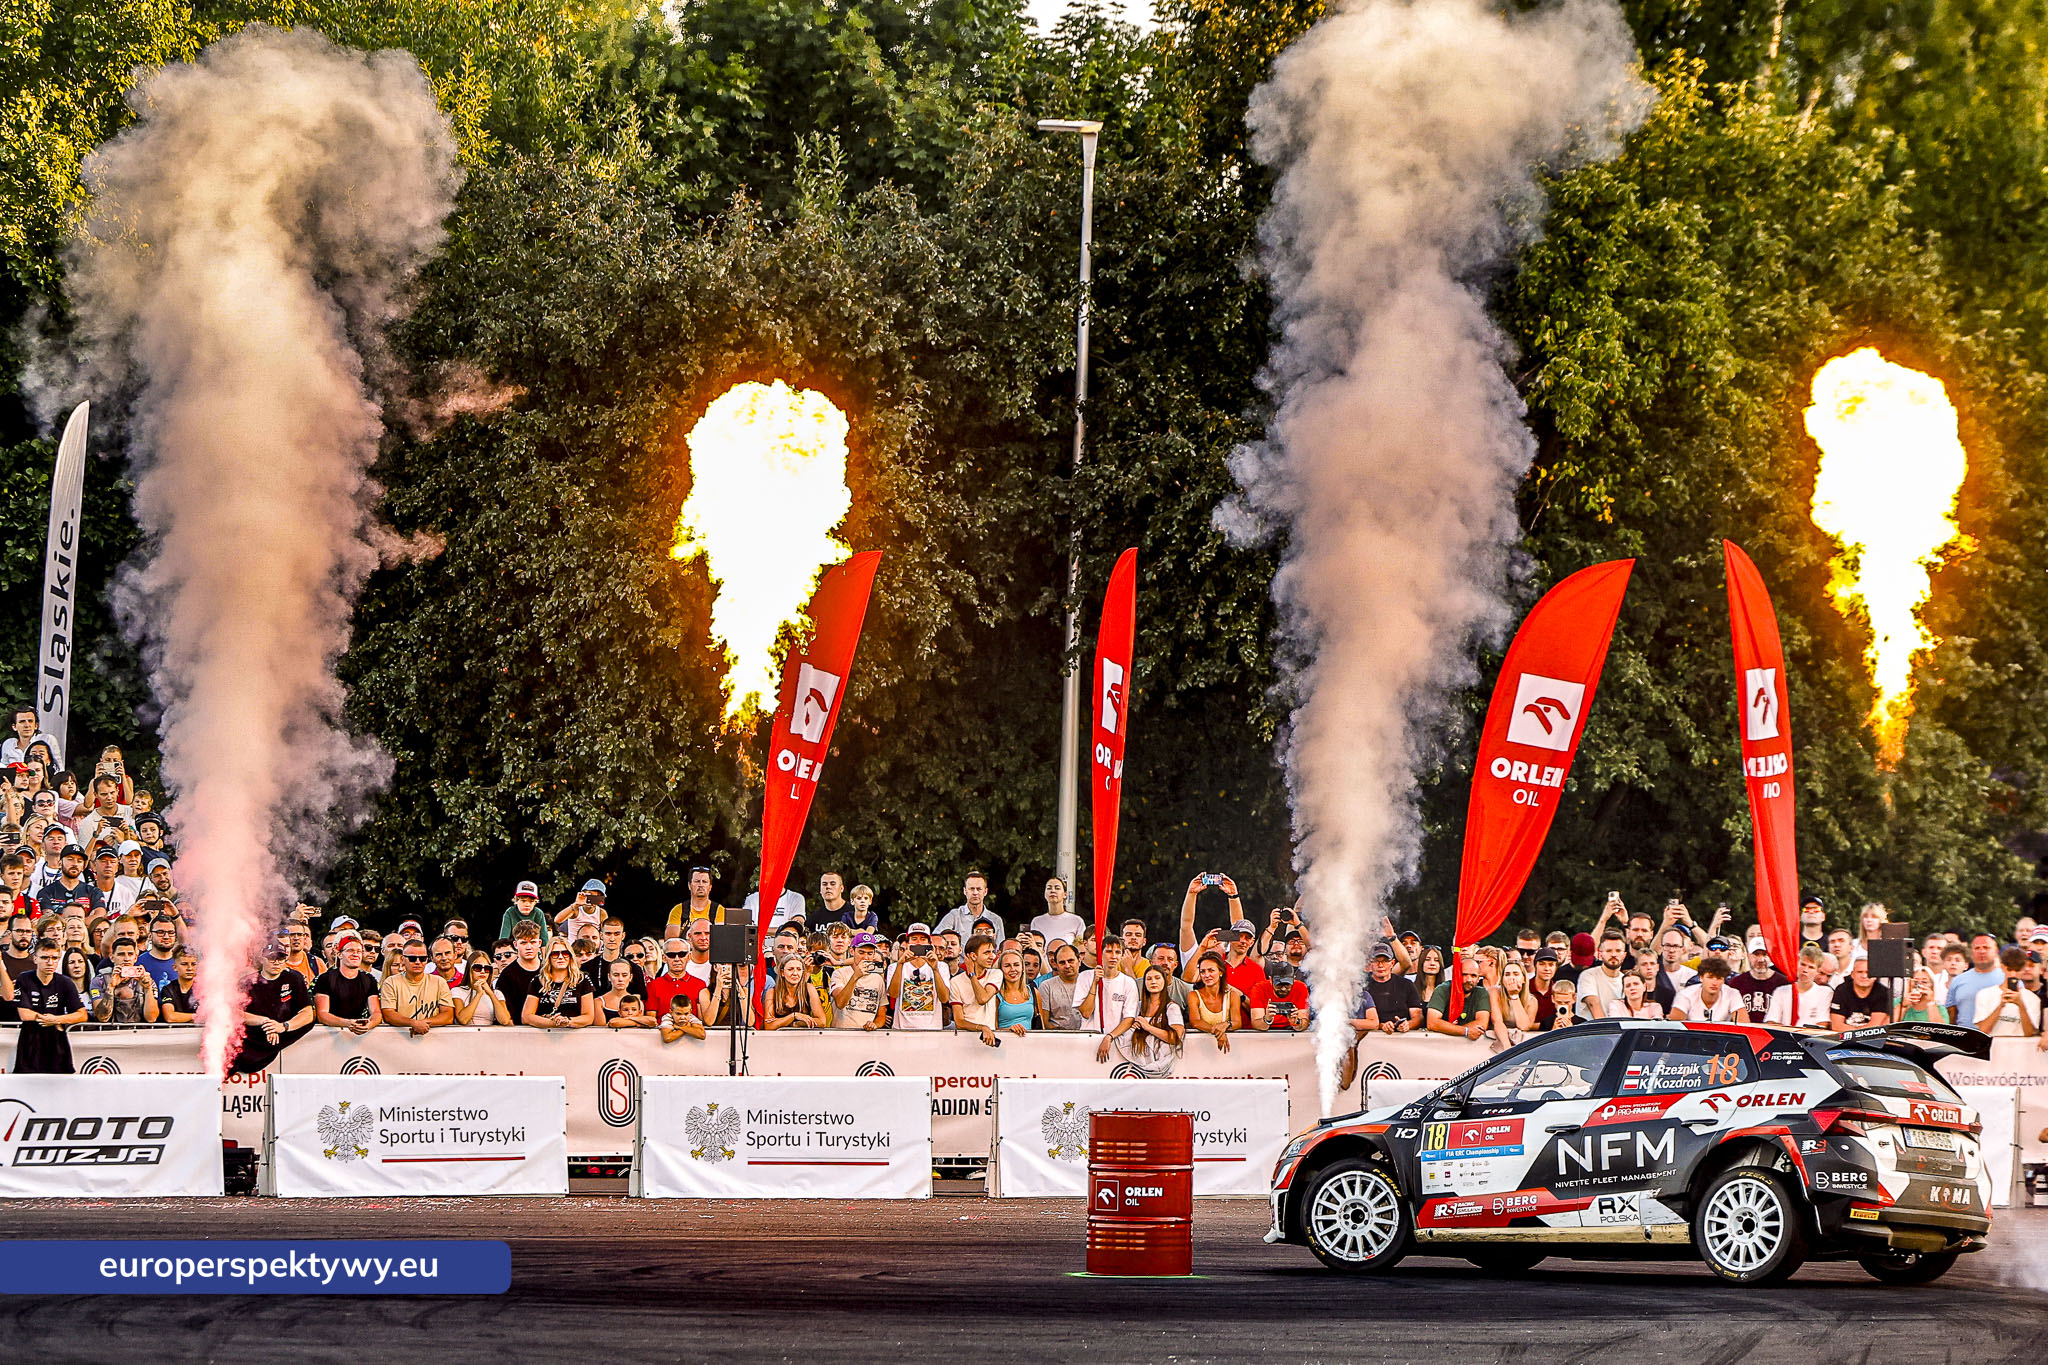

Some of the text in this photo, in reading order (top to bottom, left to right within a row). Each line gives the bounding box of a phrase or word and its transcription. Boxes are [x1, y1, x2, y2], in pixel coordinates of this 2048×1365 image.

[40, 507, 75, 718] Śląskie.
[1490, 757, 1565, 788] ORLEN
[1512, 788, 1540, 807] OIL
[1656, 1062, 1700, 1076] Rzeźnik
[1706, 1052, 1740, 1086] 18
[1654, 1076, 1701, 1090] Kozdroń
[1946, 1071, 2048, 1087] Województw
[223, 1095, 266, 1119] LĄSK
[931, 1098, 980, 1116] ADION
[1736, 1093, 1806, 1108] ORLEN
[379, 1106, 489, 1122] Ministerstwo
[746, 1109, 855, 1125] Ministerstwo
[1930, 1108, 1959, 1124] ORLEN
[20, 1116, 175, 1141] MOTO
[379, 1126, 526, 1147] Sportu i Turystyki
[1193, 1127, 1247, 1146] rystyki
[1427, 1123, 1446, 1151] 18
[1485, 1125, 1511, 1134] ORLEN
[746, 1130, 891, 1151] Sportu i Turystyki
[15, 1146, 163, 1165] WIZJA
[1466, 1147, 1500, 1157] Championship
[1557, 1127, 1676, 1176] NFM
[1555, 1168, 1677, 1188] NIVETTE FLEET MANAGEMENT
[1831, 1172, 1868, 1182] BERG
[1125, 1186, 1163, 1197] ORLEN
[1506, 1194, 1538, 1207] BERG
[1125, 1198, 1140, 1206] OIL
[1598, 1194, 1638, 1215] RX
[1600, 1213, 1640, 1223] POLSKA
